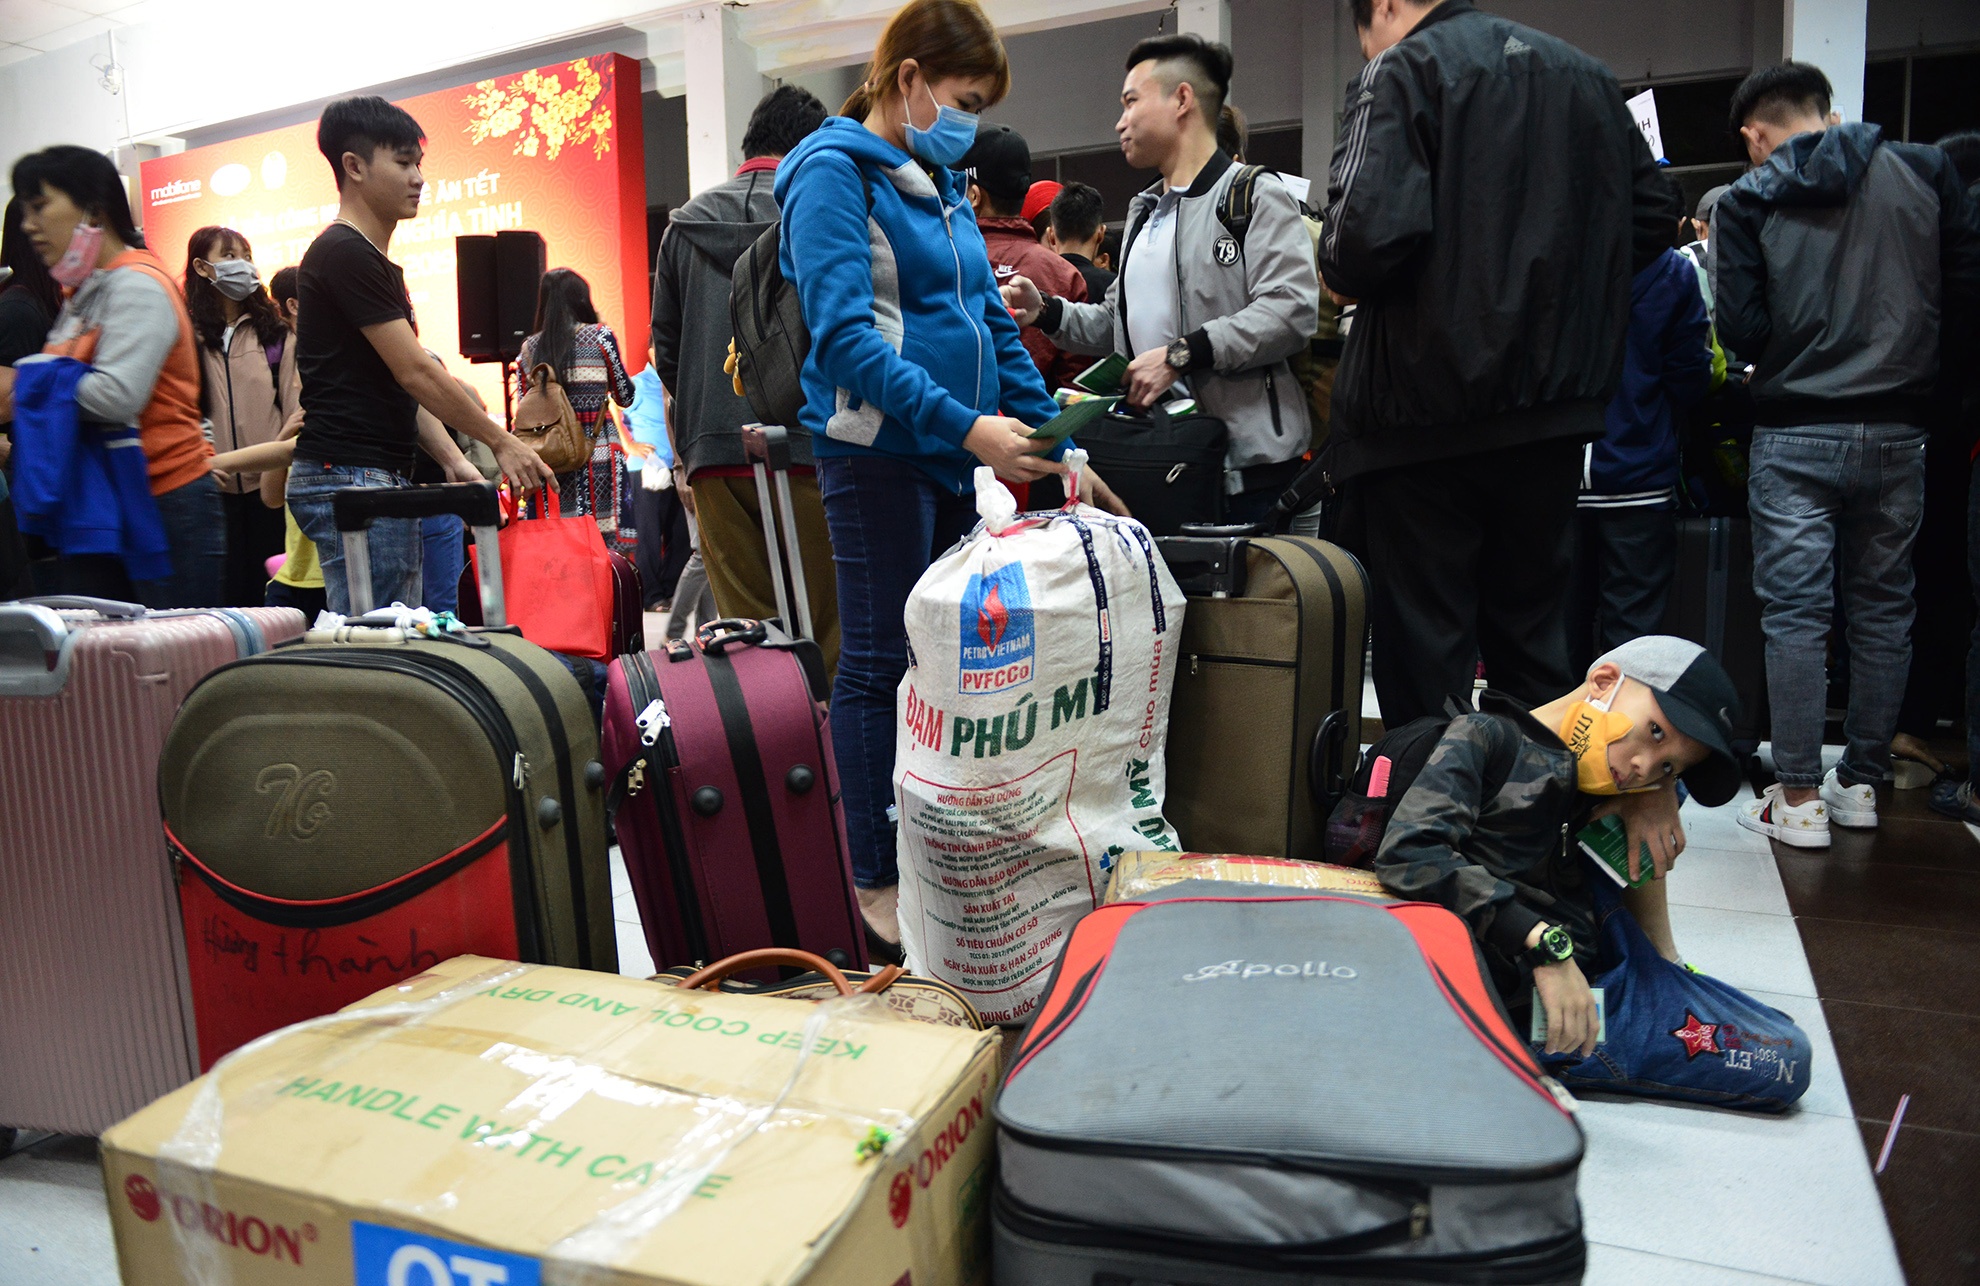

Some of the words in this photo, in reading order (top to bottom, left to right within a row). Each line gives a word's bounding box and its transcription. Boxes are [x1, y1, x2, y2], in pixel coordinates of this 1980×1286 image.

[151, 179, 201, 199] mobifone
[435, 179, 462, 204] ĂN
[464, 168, 500, 198] TẾT
[466, 201, 522, 233] TÌNH
[1217, 243, 1236, 260] 79
[963, 633, 1031, 660] PETROVIETNAM
[962, 664, 1029, 690] PVFCCo
[1139, 700, 1155, 749] Cho
[1149, 638, 1163, 693] mùa
[906, 683, 944, 752] ĐẠM
[951, 692, 1038, 759] PHÚ
[936, 793, 964, 807] HƯỚNG
[983, 791, 995, 804] SỬ
[997, 785, 1022, 802] DỤNG
[1125, 757, 1158, 809] MỸ
[923, 836, 949, 851] THÔNG
[949, 842, 961, 853] TIN
[962, 841, 985, 853] CẢNH
[941, 874, 968, 889] HƯỚNG
[969, 874, 987, 887] DẪN
[963, 901, 979, 914] SẢN
[980, 898, 1001, 913] XUẤT
[1002, 892, 1015, 905] TẠI
[943, 957, 961, 972] NGÀY
[961, 963, 977, 975] SẢN
[978, 963, 999, 975] XUẤT
[1000, 963, 1007, 973] &
[1008, 954, 1027, 969] HẠN
[1027, 942, 1039, 959] SỬ
[1040, 927, 1062, 950] DỤNG
[966, 937, 984, 950] TIÊU
[985, 931, 1015, 949] CHUẨN
[970, 952, 982, 960] TCCS
[1182, 959, 1358, 983] Apollo
[476, 985, 552, 1003] DRY
[557, 993, 639, 1018] AND
[650, 1009, 751, 1037] COOL
[757, 1030, 868, 1061] KEEP
[1701, 1024, 1713, 1051] JEANS
[1754, 1047, 1778, 1064] 3301
[276, 1076, 461, 1131] HANDLE
[917, 1095, 983, 1190] ORION
[171, 1195, 304, 1268] ORION
